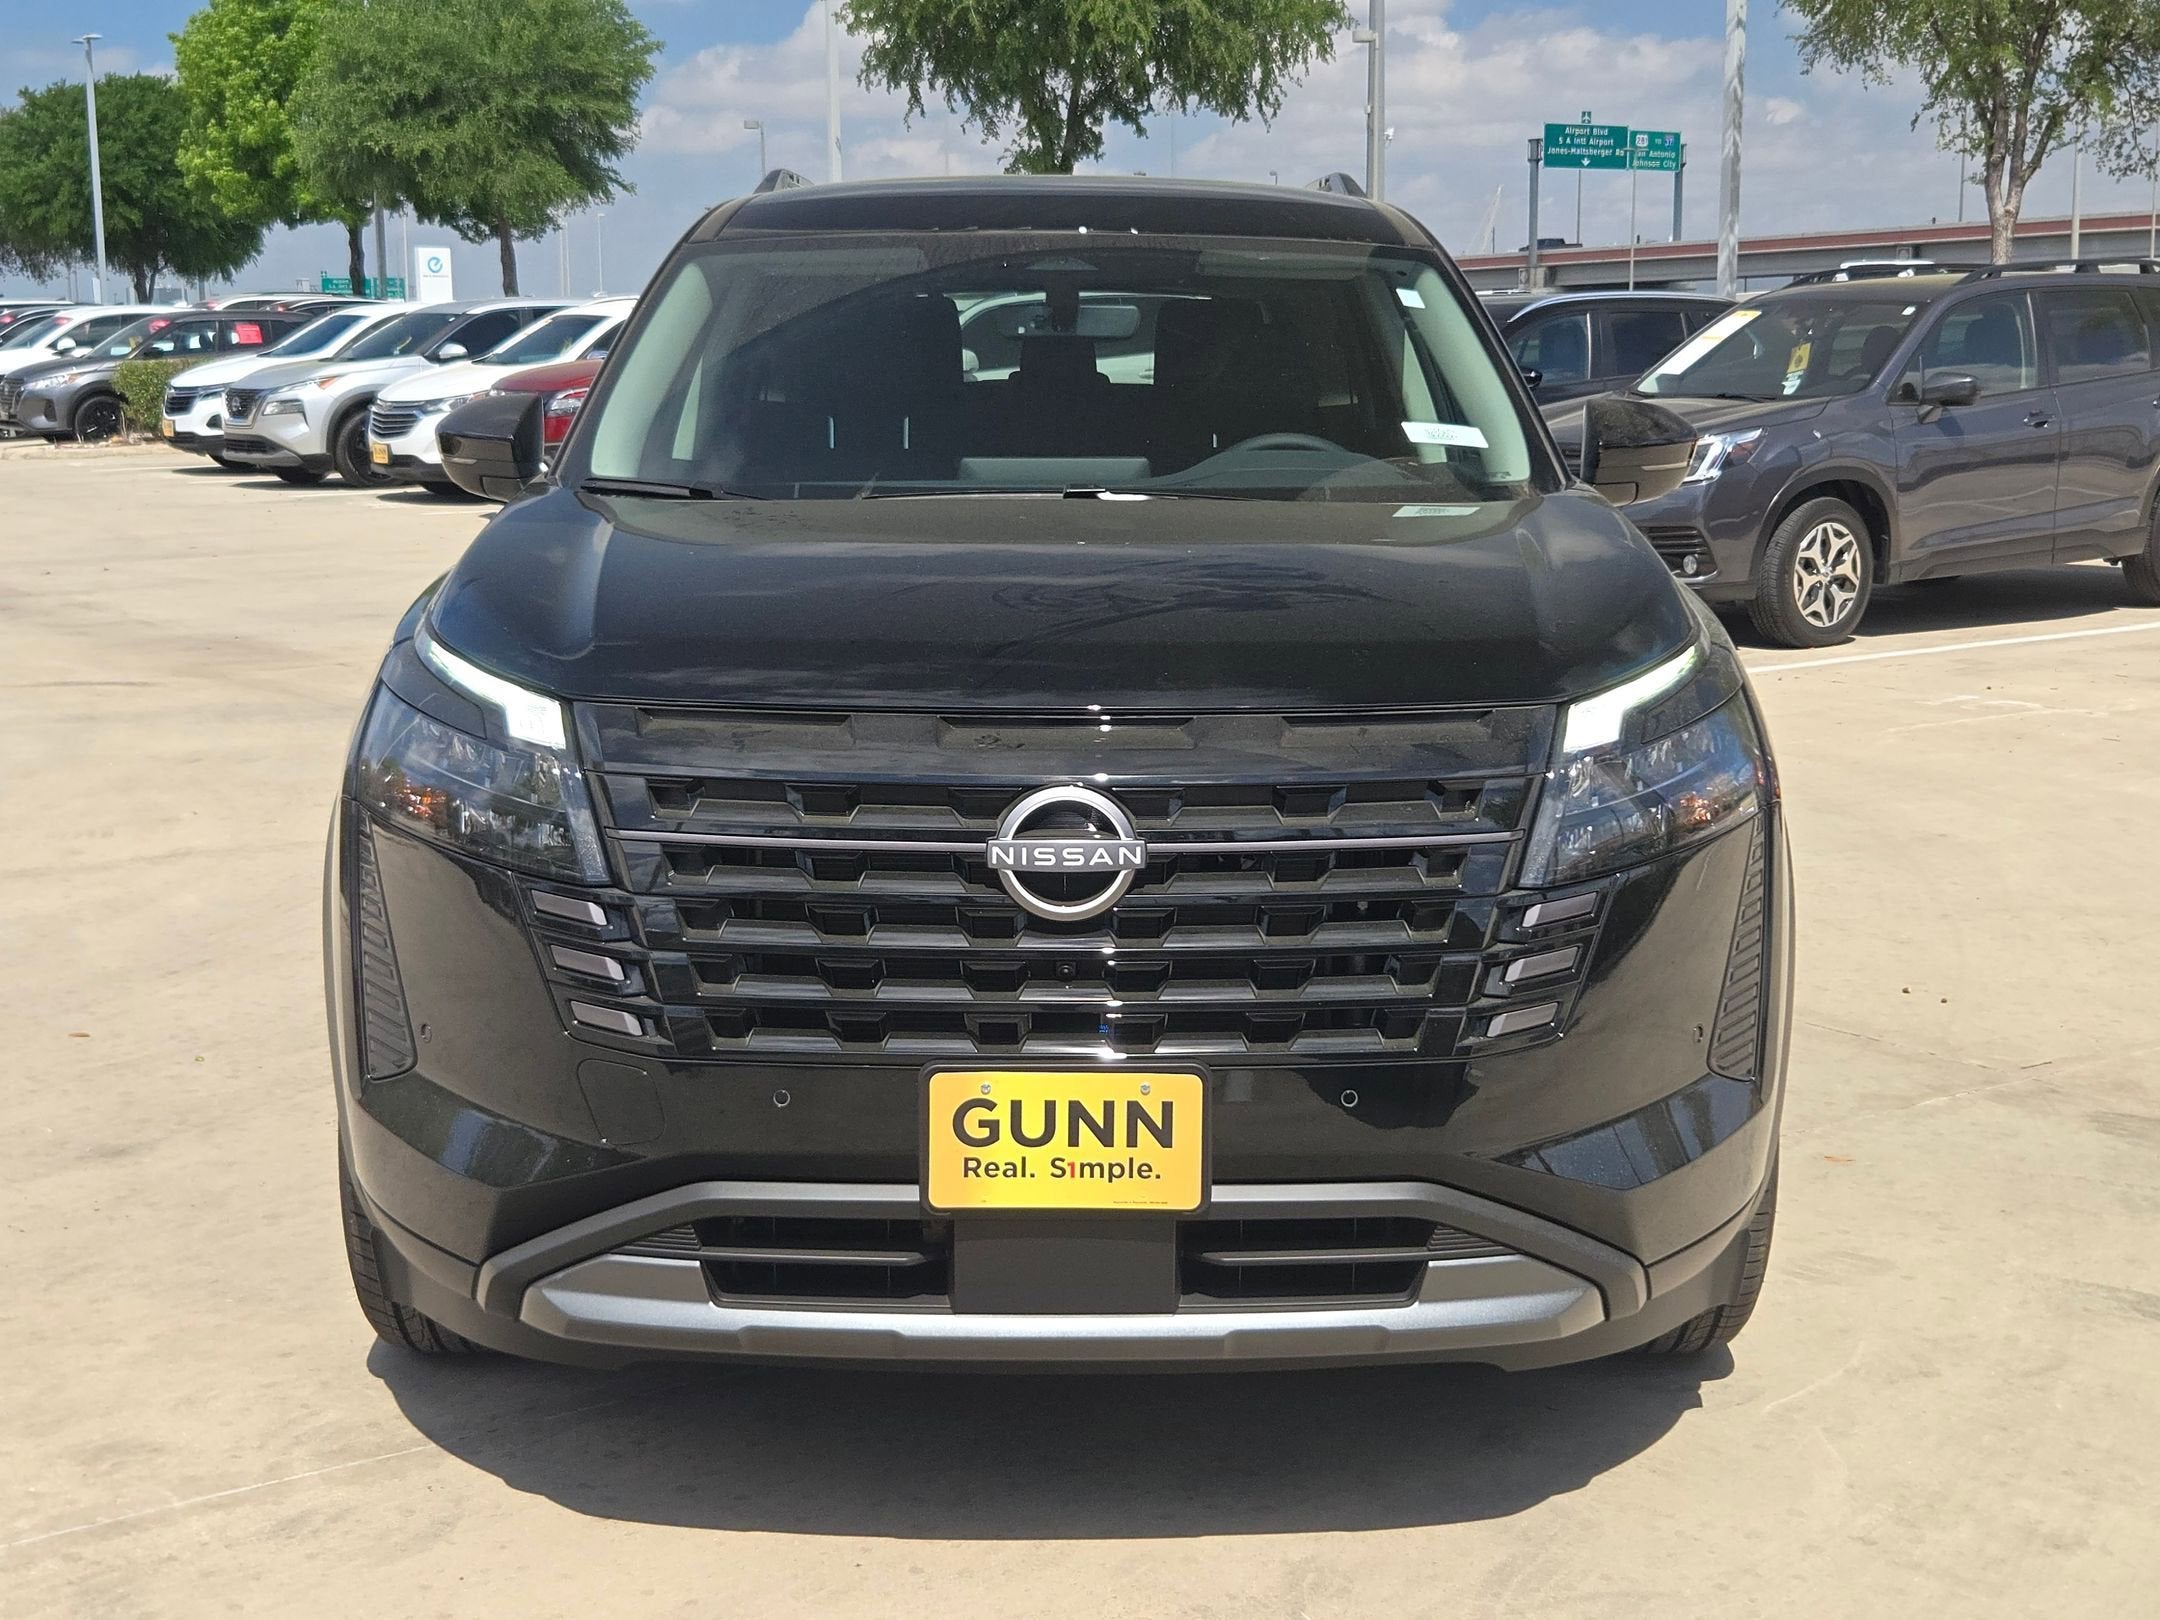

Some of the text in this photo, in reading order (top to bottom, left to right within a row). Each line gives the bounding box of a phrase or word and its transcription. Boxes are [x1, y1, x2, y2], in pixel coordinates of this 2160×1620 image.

[1565, 128, 1608, 136] Airport Blvd
[1588, 138, 1614, 147] Airport
[1649, 150, 1676, 158] Antonio
[1663, 159, 1676, 169] City
[991, 846, 1141, 866] NISSAN
[952, 1098, 1174, 1148] GUNN
[963, 1156, 1036, 1178] Real.
